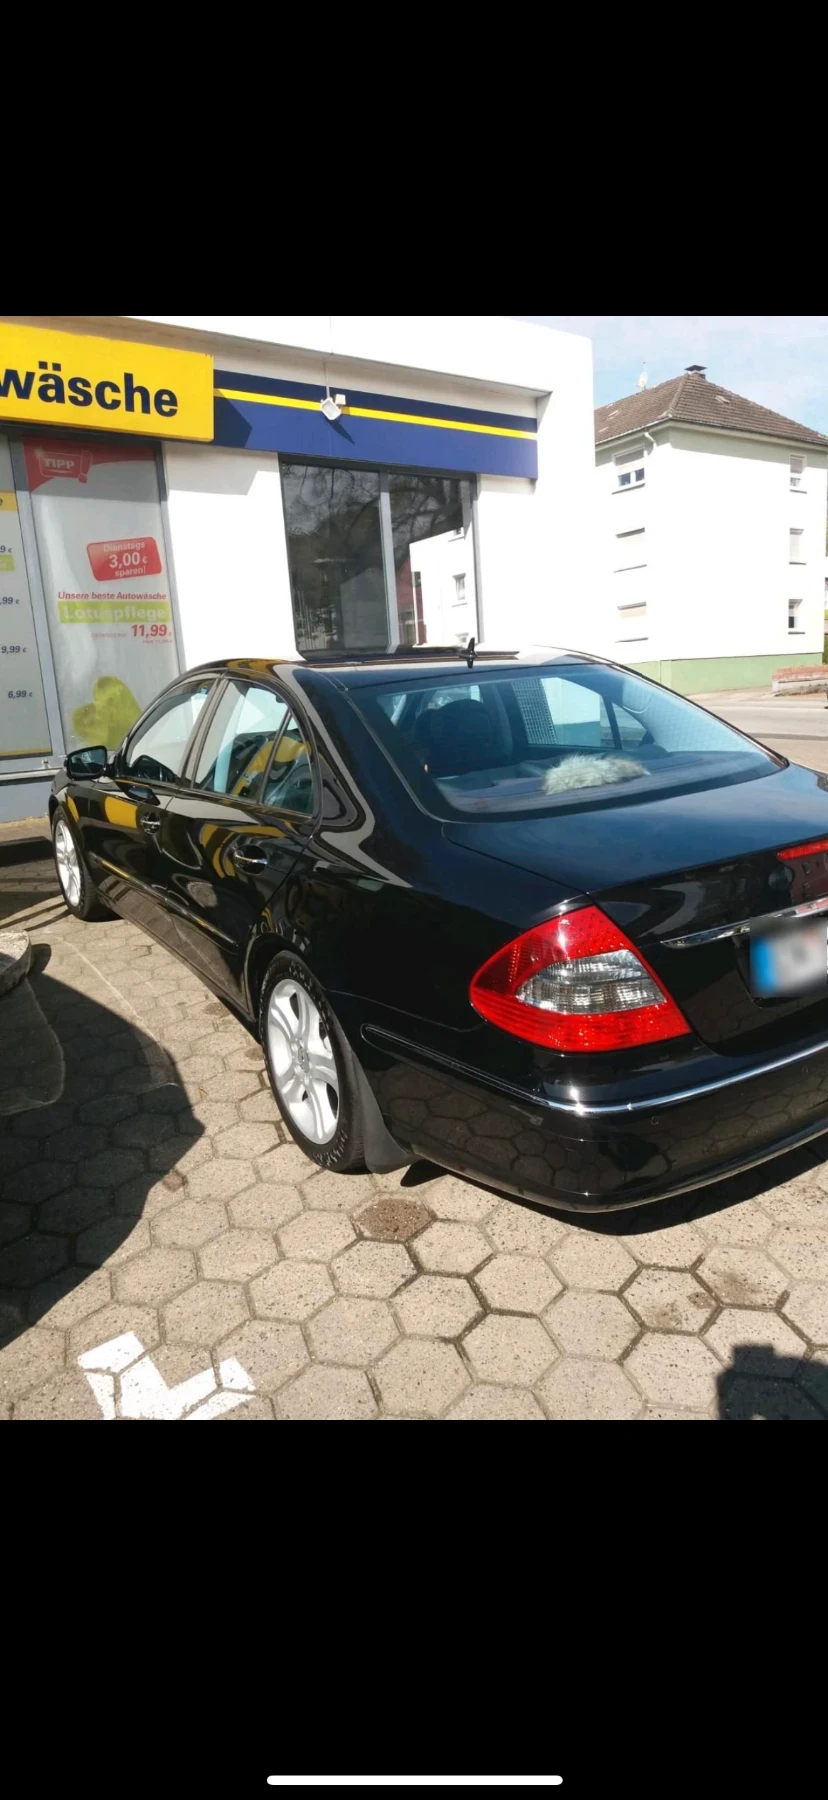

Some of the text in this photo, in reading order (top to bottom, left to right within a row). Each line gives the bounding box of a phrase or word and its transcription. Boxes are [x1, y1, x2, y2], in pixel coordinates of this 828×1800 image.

[0, 361, 178, 417] wäsche
[103, 541, 145, 552] Dienstags
[109, 552, 140, 569] 3,00
[115, 566, 146, 577] sparen!
[58, 592, 167, 600] Unsere beste Autowäsche
[63, 605, 166, 622] Lotuspflege
[132, 624, 167, 638] 11,99
[8, 690, 27, 699] 6,99
